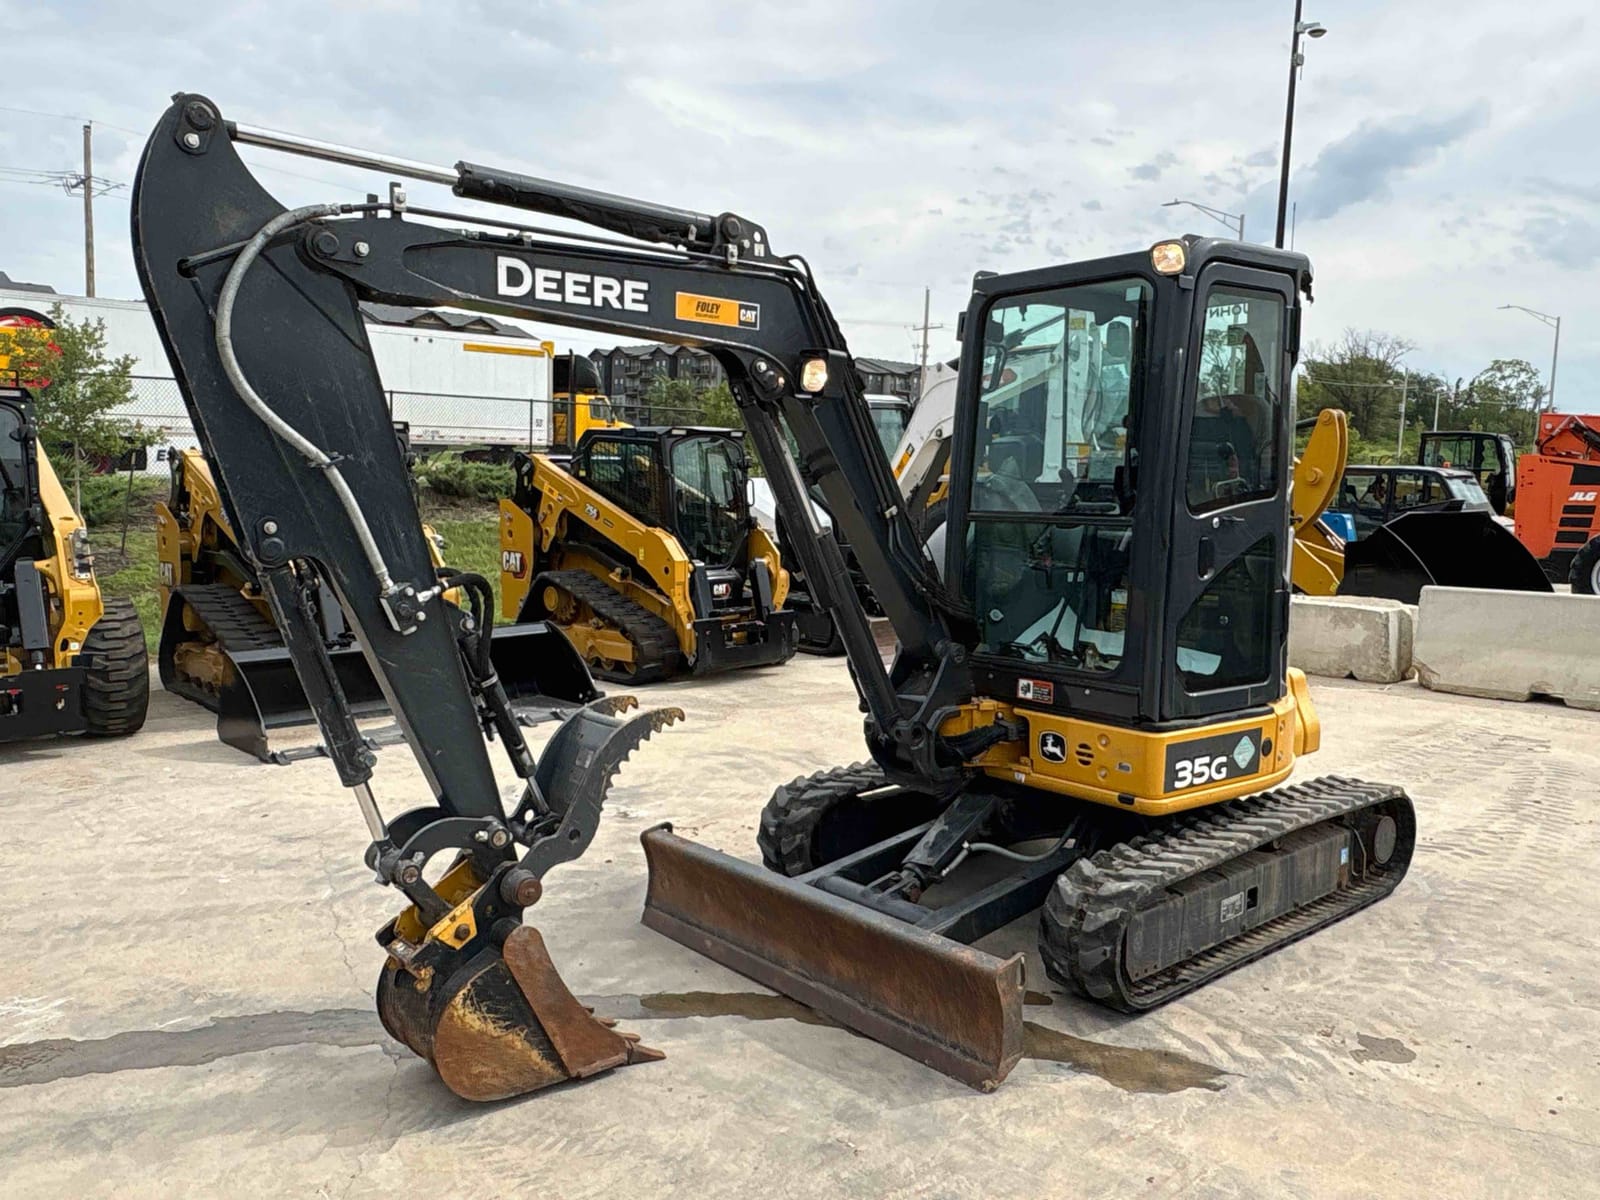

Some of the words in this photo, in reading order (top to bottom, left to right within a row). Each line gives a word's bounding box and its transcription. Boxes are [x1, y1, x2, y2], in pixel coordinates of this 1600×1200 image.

[497, 256, 649, 312] DEERE
[696, 301, 721, 314] FOLEY
[740, 309, 757, 323] CAT
[1568, 491, 1598, 502] JLG
[502, 550, 522, 573] CAT
[1174, 756, 1228, 788] 35G
